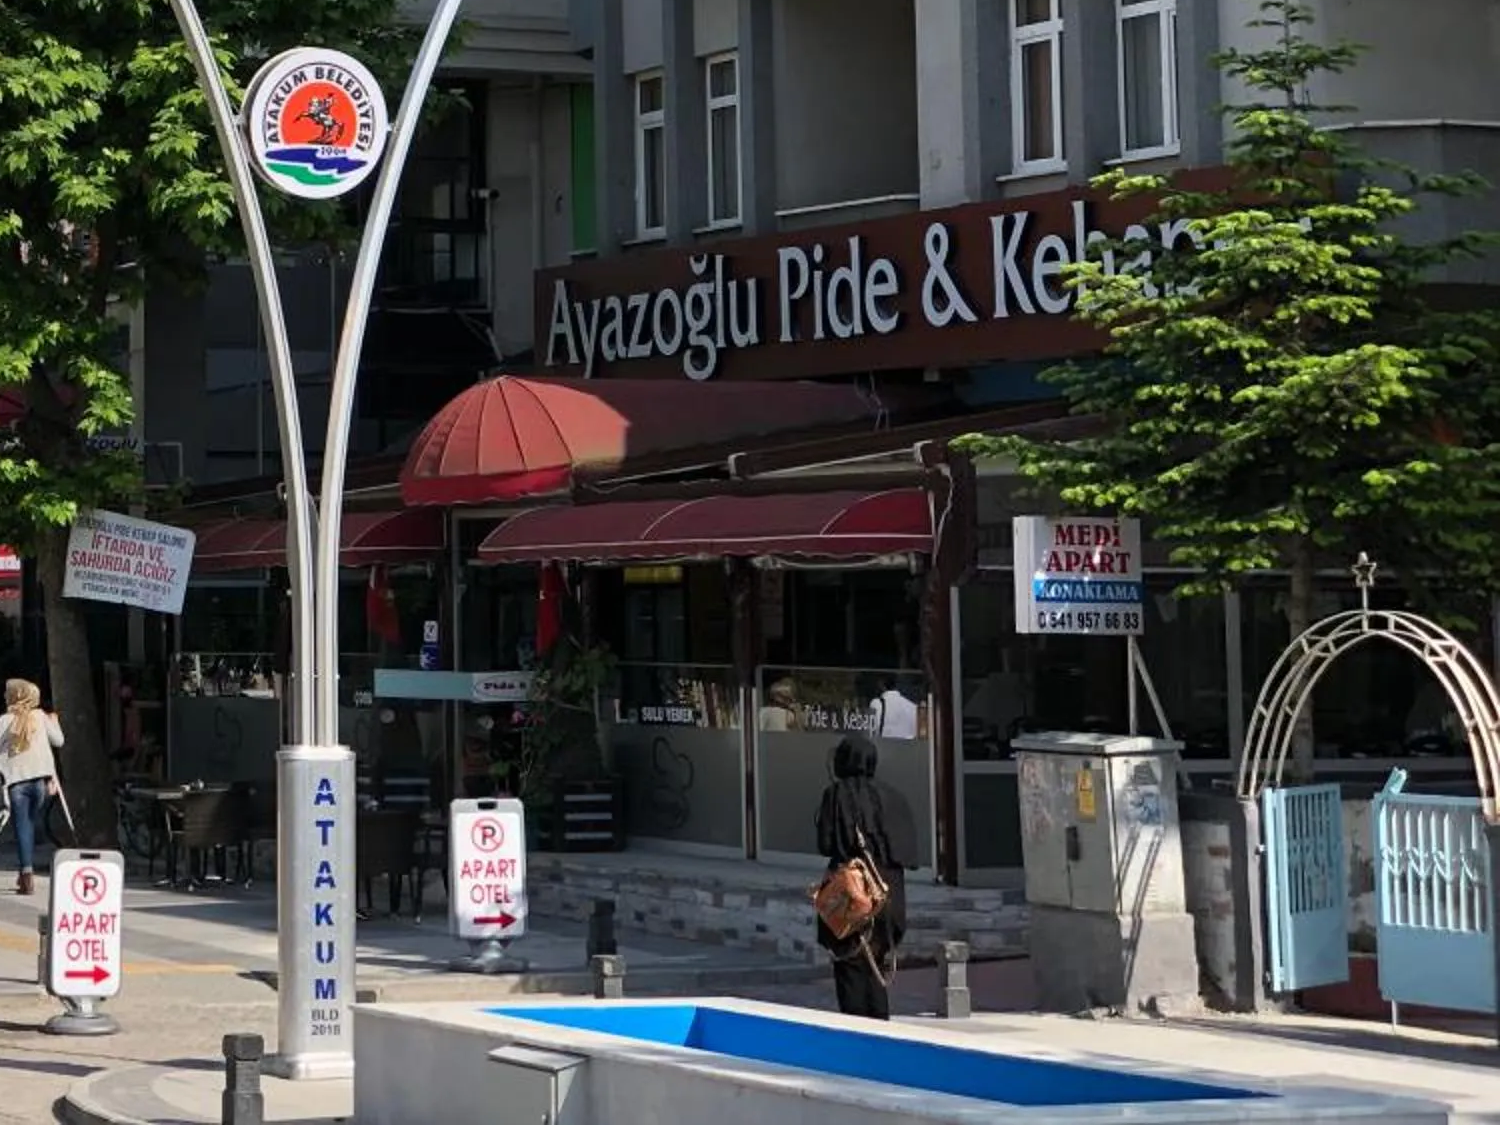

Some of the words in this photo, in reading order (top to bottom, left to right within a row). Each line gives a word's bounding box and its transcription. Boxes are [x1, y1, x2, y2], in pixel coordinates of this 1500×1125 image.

[267, 71, 308, 143] ATAKUM
[545, 253, 759, 380] Ayazoğlu
[778, 235, 900, 342] Pide
[921, 222, 978, 328] &
[1054, 518, 1121, 547] MEDİ
[1045, 550, 1131, 573] APART
[1041, 582, 1139, 600] KONAKLAMA
[1077, 612, 1101, 629] 957
[1105, 612, 1120, 629] 66
[1124, 612, 1140, 630] 83
[460, 858, 517, 880] APART
[313, 777, 337, 1001] ATAKUM
[469, 883, 512, 904] OTEL
[57, 911, 117, 935] APART
[65, 939, 109, 962] OTEL
[310, 1008, 339, 1022] BLD
